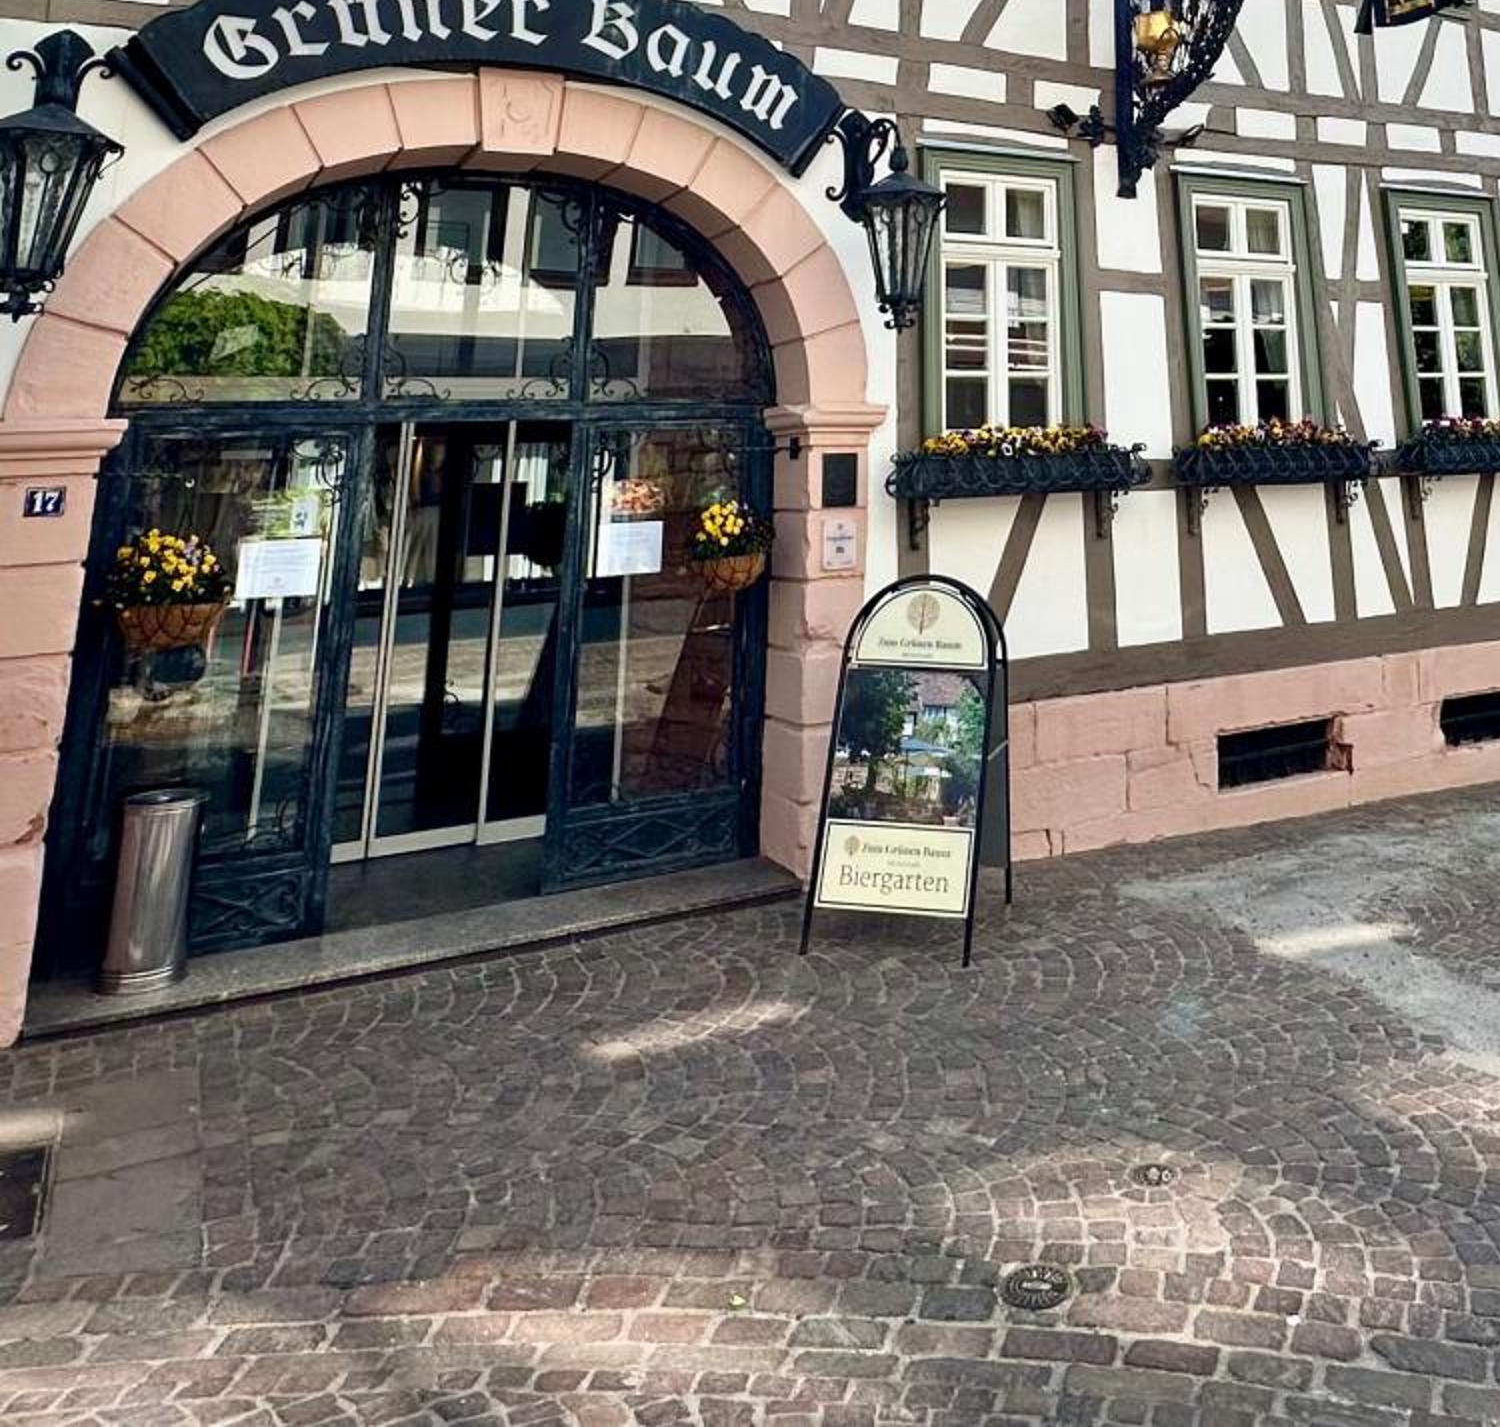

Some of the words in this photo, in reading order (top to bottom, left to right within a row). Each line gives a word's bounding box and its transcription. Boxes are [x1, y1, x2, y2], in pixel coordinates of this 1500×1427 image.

[33, 491, 60, 512] 17
[885, 843, 921, 857] Grünen
[839, 863, 950, 895] Biergarten
